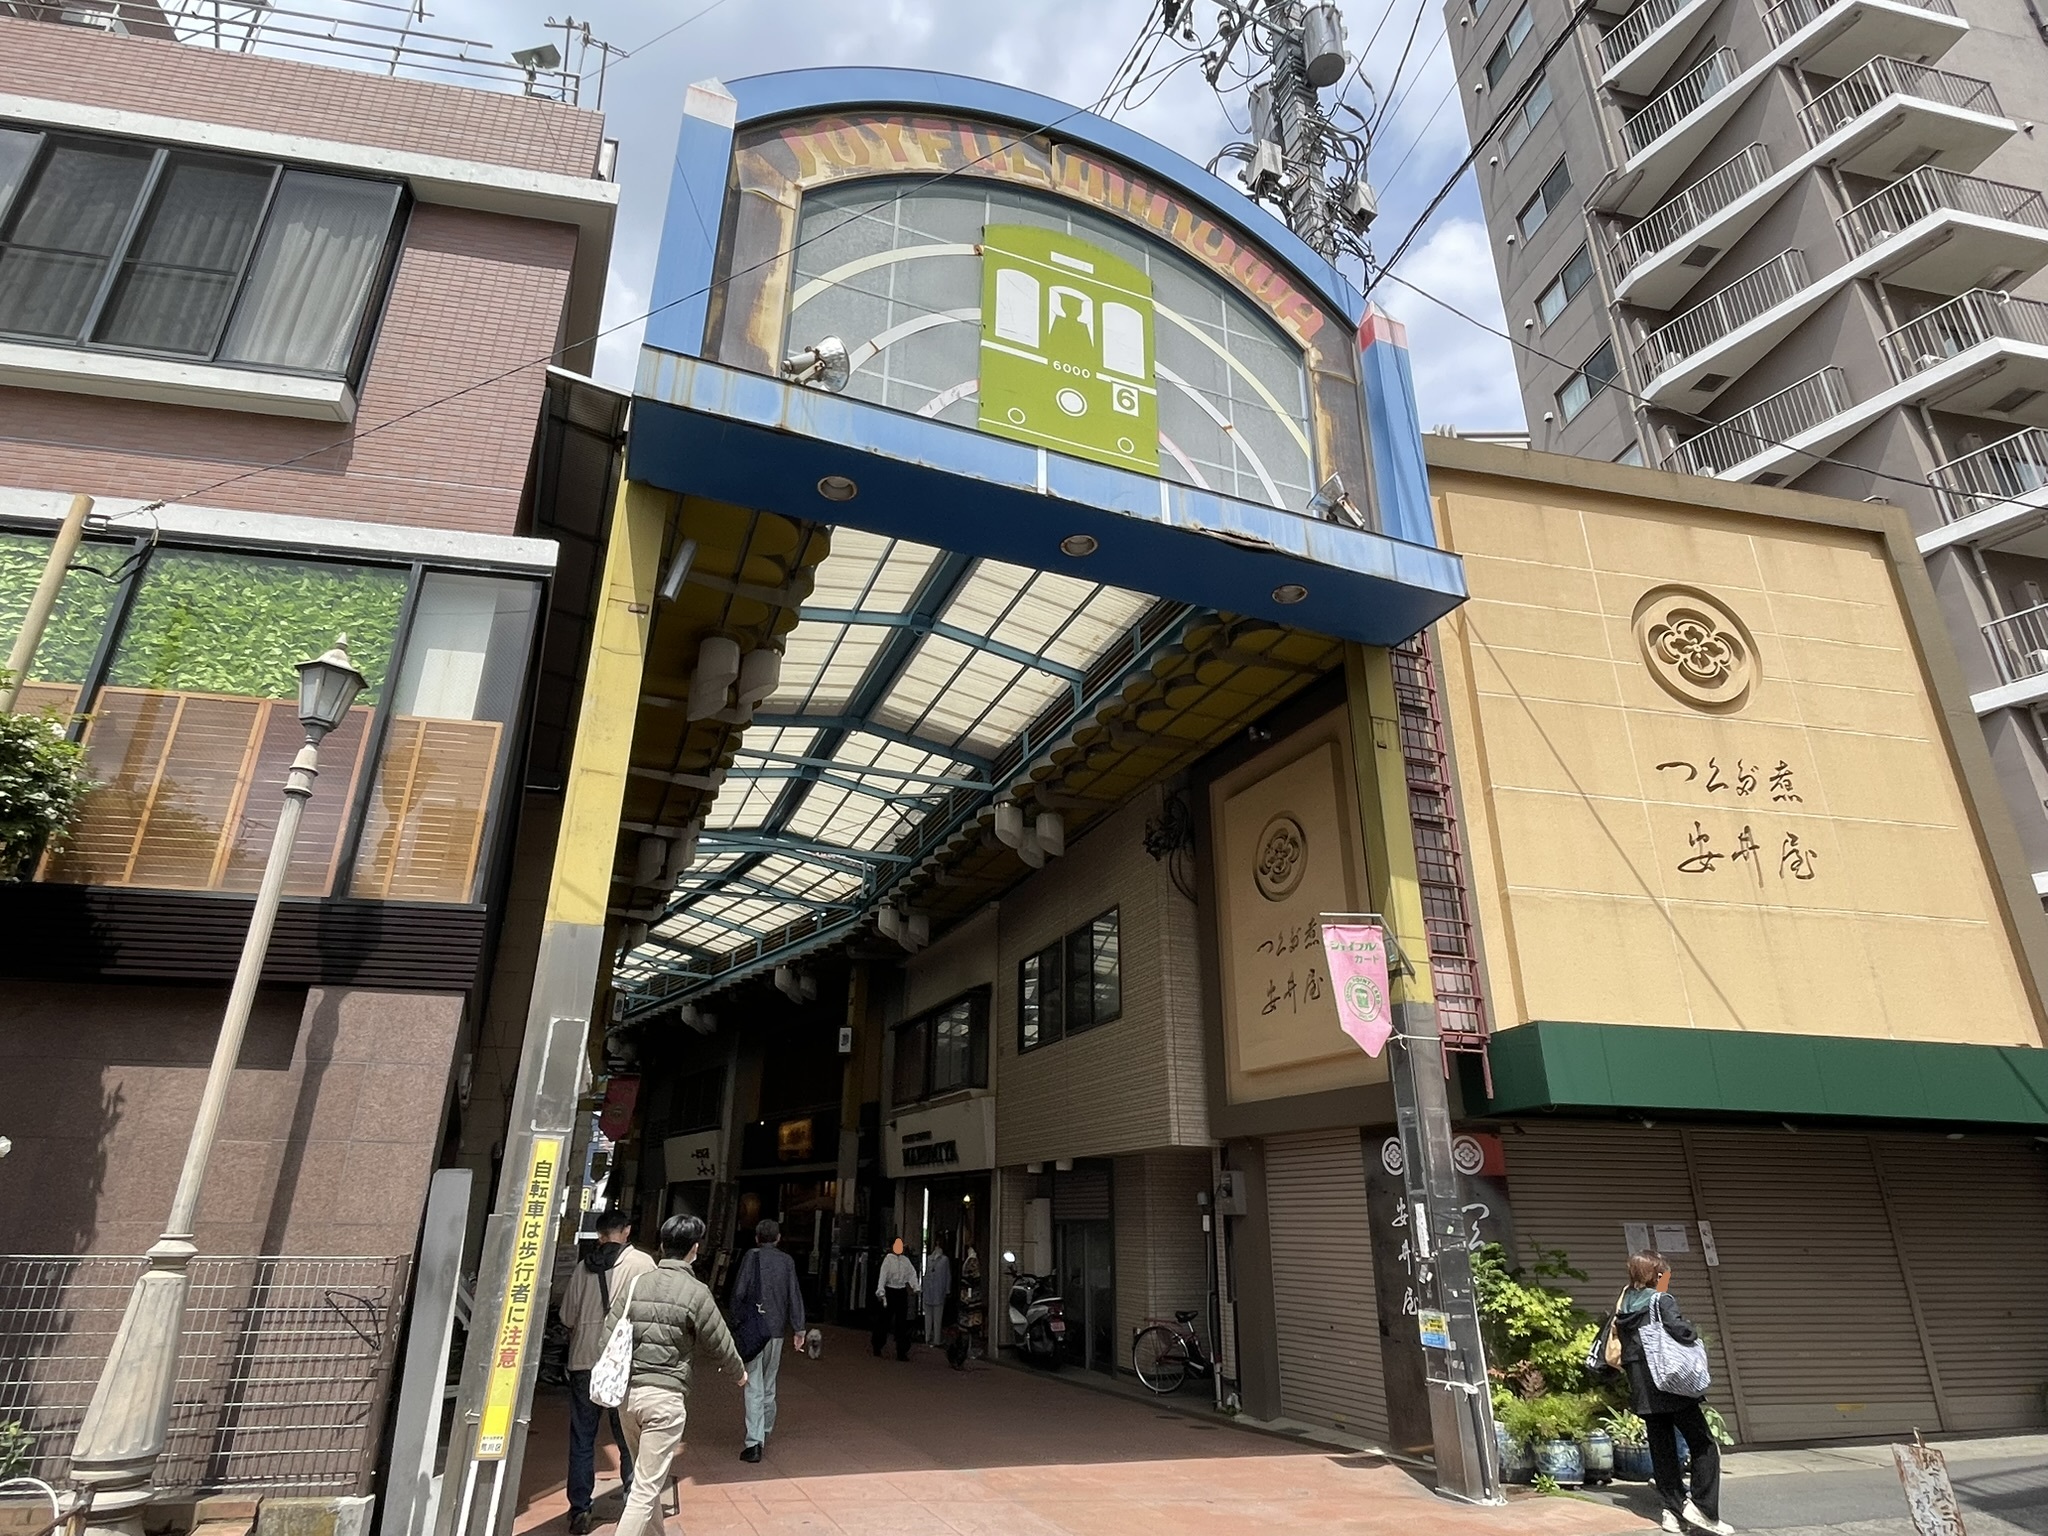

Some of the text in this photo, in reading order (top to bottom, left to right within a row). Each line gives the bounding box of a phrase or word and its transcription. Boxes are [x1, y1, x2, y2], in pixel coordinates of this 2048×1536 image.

[780, 116, 1045, 179] JOYFUL
[1052, 360, 1091, 379] 6000
[1116, 387, 1136, 411] 6
[1676, 820, 1818, 889] 安井屋
[496, 1160, 553, 1369] 自転車は歩行者に注意
